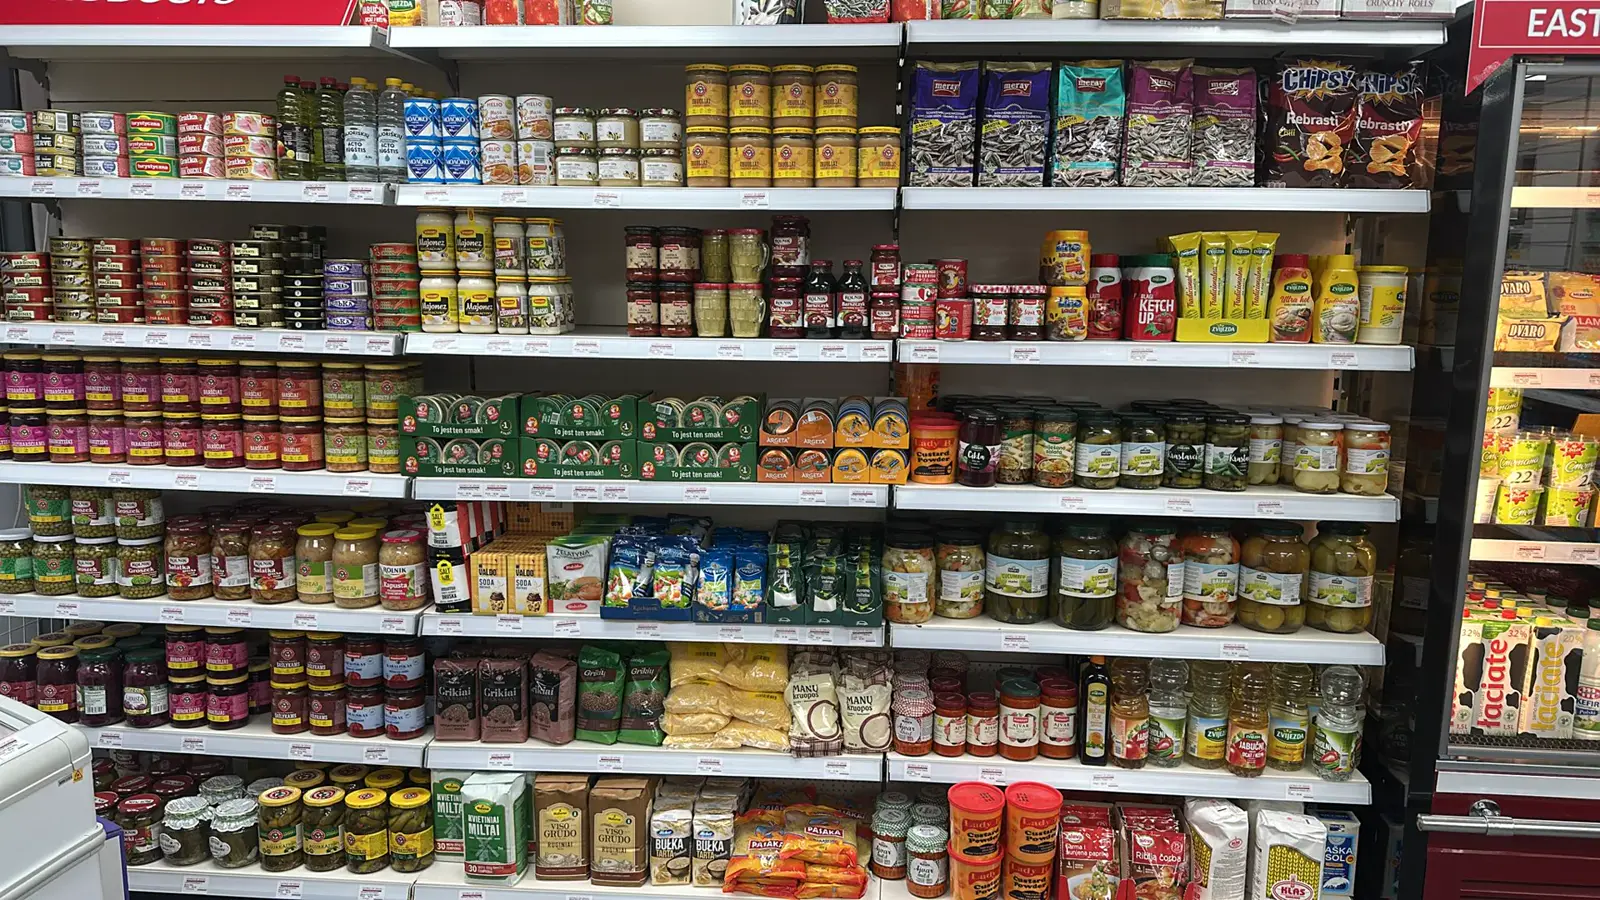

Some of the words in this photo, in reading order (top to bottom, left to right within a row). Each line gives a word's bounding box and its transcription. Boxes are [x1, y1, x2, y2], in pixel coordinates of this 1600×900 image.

[935, 82, 960, 92] meray
[1004, 82, 1029, 92] meray
[1077, 78, 1105, 89] meray
[1286, 111, 1338, 127] Rebrasti
[57, 135, 63, 144] 4
[57, 156, 63, 165] 4
[466, 302, 493, 312] Majonez
[1139, 299, 1174, 312] KETCH
[1138, 312, 1154, 324] UP
[1508, 324, 1545, 338] DVARO
[1492, 415, 1513, 429] 22
[432, 425, 440, 433] To
[440, 426, 452, 435] jest
[463, 426, 483, 434] smak!
[562, 428, 574, 437] jest
[672, 430, 680, 438] To
[680, 431, 692, 440] jest
[803, 438, 825, 446] ARGETA
[916, 450, 950, 458] Custard
[917, 456, 950, 464] Powder
[442, 466, 454, 475] jest
[466, 466, 486, 474] smak!
[561, 468, 573, 477] jest
[584, 468, 604, 477] smak!
[671, 470, 679, 478] To
[679, 471, 691, 480] jest
[1510, 471, 1533, 483] 22
[431, 513, 443, 521] SALT
[439, 567, 451, 576] SALT
[478, 568, 497, 577] VALDO
[515, 568, 534, 577] VALDO
[383, 582, 408, 590] Kapusta
[479, 578, 495, 586] SODA
[515, 579, 532, 587] SODA
[438, 686, 471, 698] Grikiai
[484, 687, 517, 698] Grikiai
[793, 691, 820, 700] kruopos
[846, 703, 873, 713] kruopos
[1276, 731, 1304, 743] ZVIJEZDA
[468, 815, 499, 824] KVIETINIAI
[963, 819, 990, 829] Lady
[1022, 817, 1047, 828] Lady
[468, 823, 500, 836] MILTAI
[550, 823, 570, 831] VISO
[543, 829, 577, 838] GRŪDO
[605, 828, 624, 836] VISO
[967, 829, 999, 839] Custard
[1024, 828, 1056, 837] Custard
[598, 834, 631, 844] GRŪDO
[968, 836, 999, 844] Powder
[1025, 834, 1056, 842] Powder
[437, 842, 446, 851] 30
[655, 839, 684, 850] BUŁKA
[696, 840, 724, 852] BUŁKA
[655, 850, 674, 858] TARTA
[696, 851, 715, 859] TARTA
[1324, 854, 1345, 863] SOL
[468, 864, 477, 873] 30
[1011, 865, 1036, 876] Lady
[970, 871, 996, 881] Lady
[1012, 876, 1046, 884] Custard
[1013, 882, 1047, 890] Powder
[1281, 886, 1306, 897] KLAS
